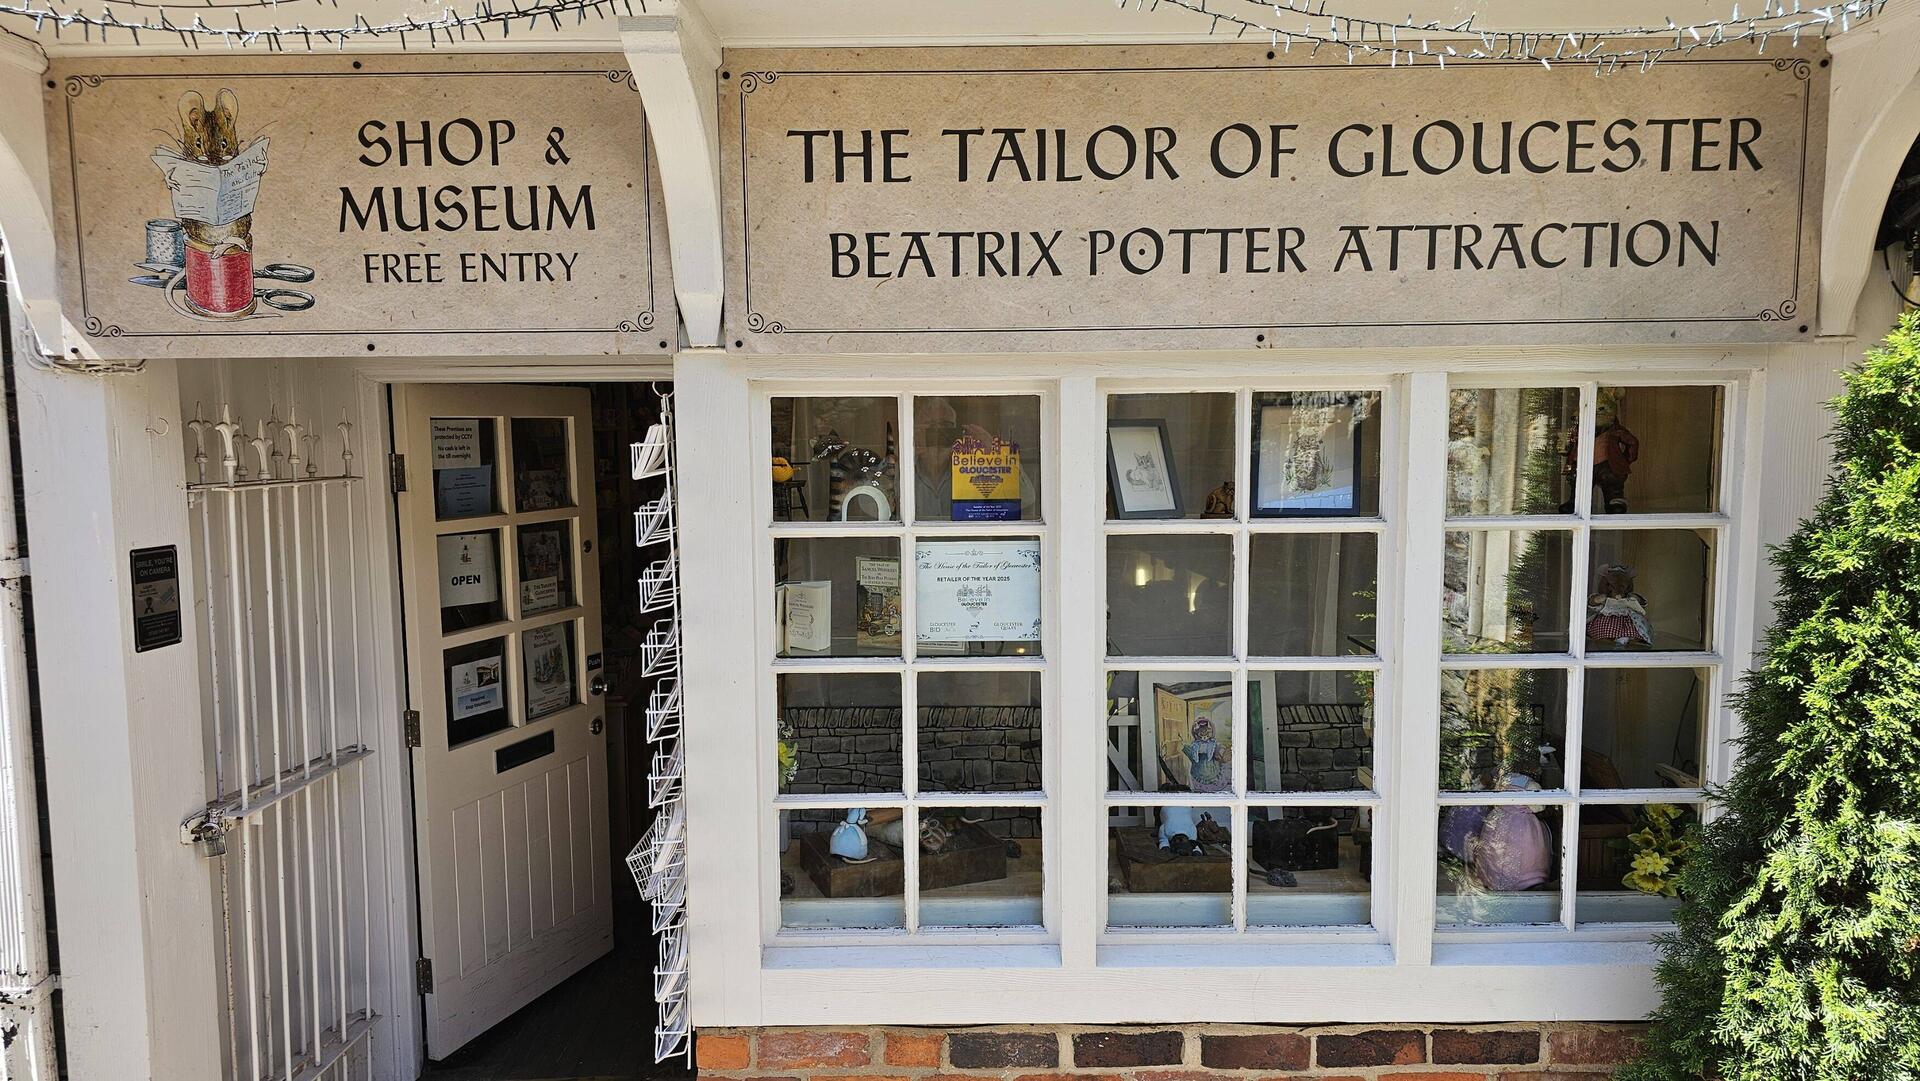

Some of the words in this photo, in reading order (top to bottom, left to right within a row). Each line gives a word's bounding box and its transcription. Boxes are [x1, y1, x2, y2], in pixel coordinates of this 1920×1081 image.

[357, 117, 517, 168] SHOP
[544, 126, 572, 166] &
[786, 128, 913, 184] THE
[941, 124, 1181, 183] TAILOR
[1210, 122, 1299, 179] OF
[1328, 117, 1764, 178] GLOUCESTER
[222, 169, 234, 178] The
[339, 184, 596, 233] MUSEUM
[829, 230, 1064, 279] BEATRIX
[1088, 226, 1309, 276] POTTER
[1333, 218, 1721, 273] ATTRACTION
[363, 252, 445, 284] FREE
[459, 251, 579, 283] ENTRY
[953, 454, 1002, 466] Believe
[1006, 454, 1017, 466] in
[959, 466, 1012, 474] GLOUCESTER
[139, 569, 148, 577] ON
[148, 566, 171, 576] CAMERA
[919, 561, 932, 570] The
[934, 561, 954, 570] House
[955, 561, 963, 572] of
[962, 561, 971, 569] the
[972, 560, 992, 570] Tailor
[992, 560, 1001, 571] of
[1000, 560, 1031, 571] Gloucester
[451, 574, 481, 586] OPEN
